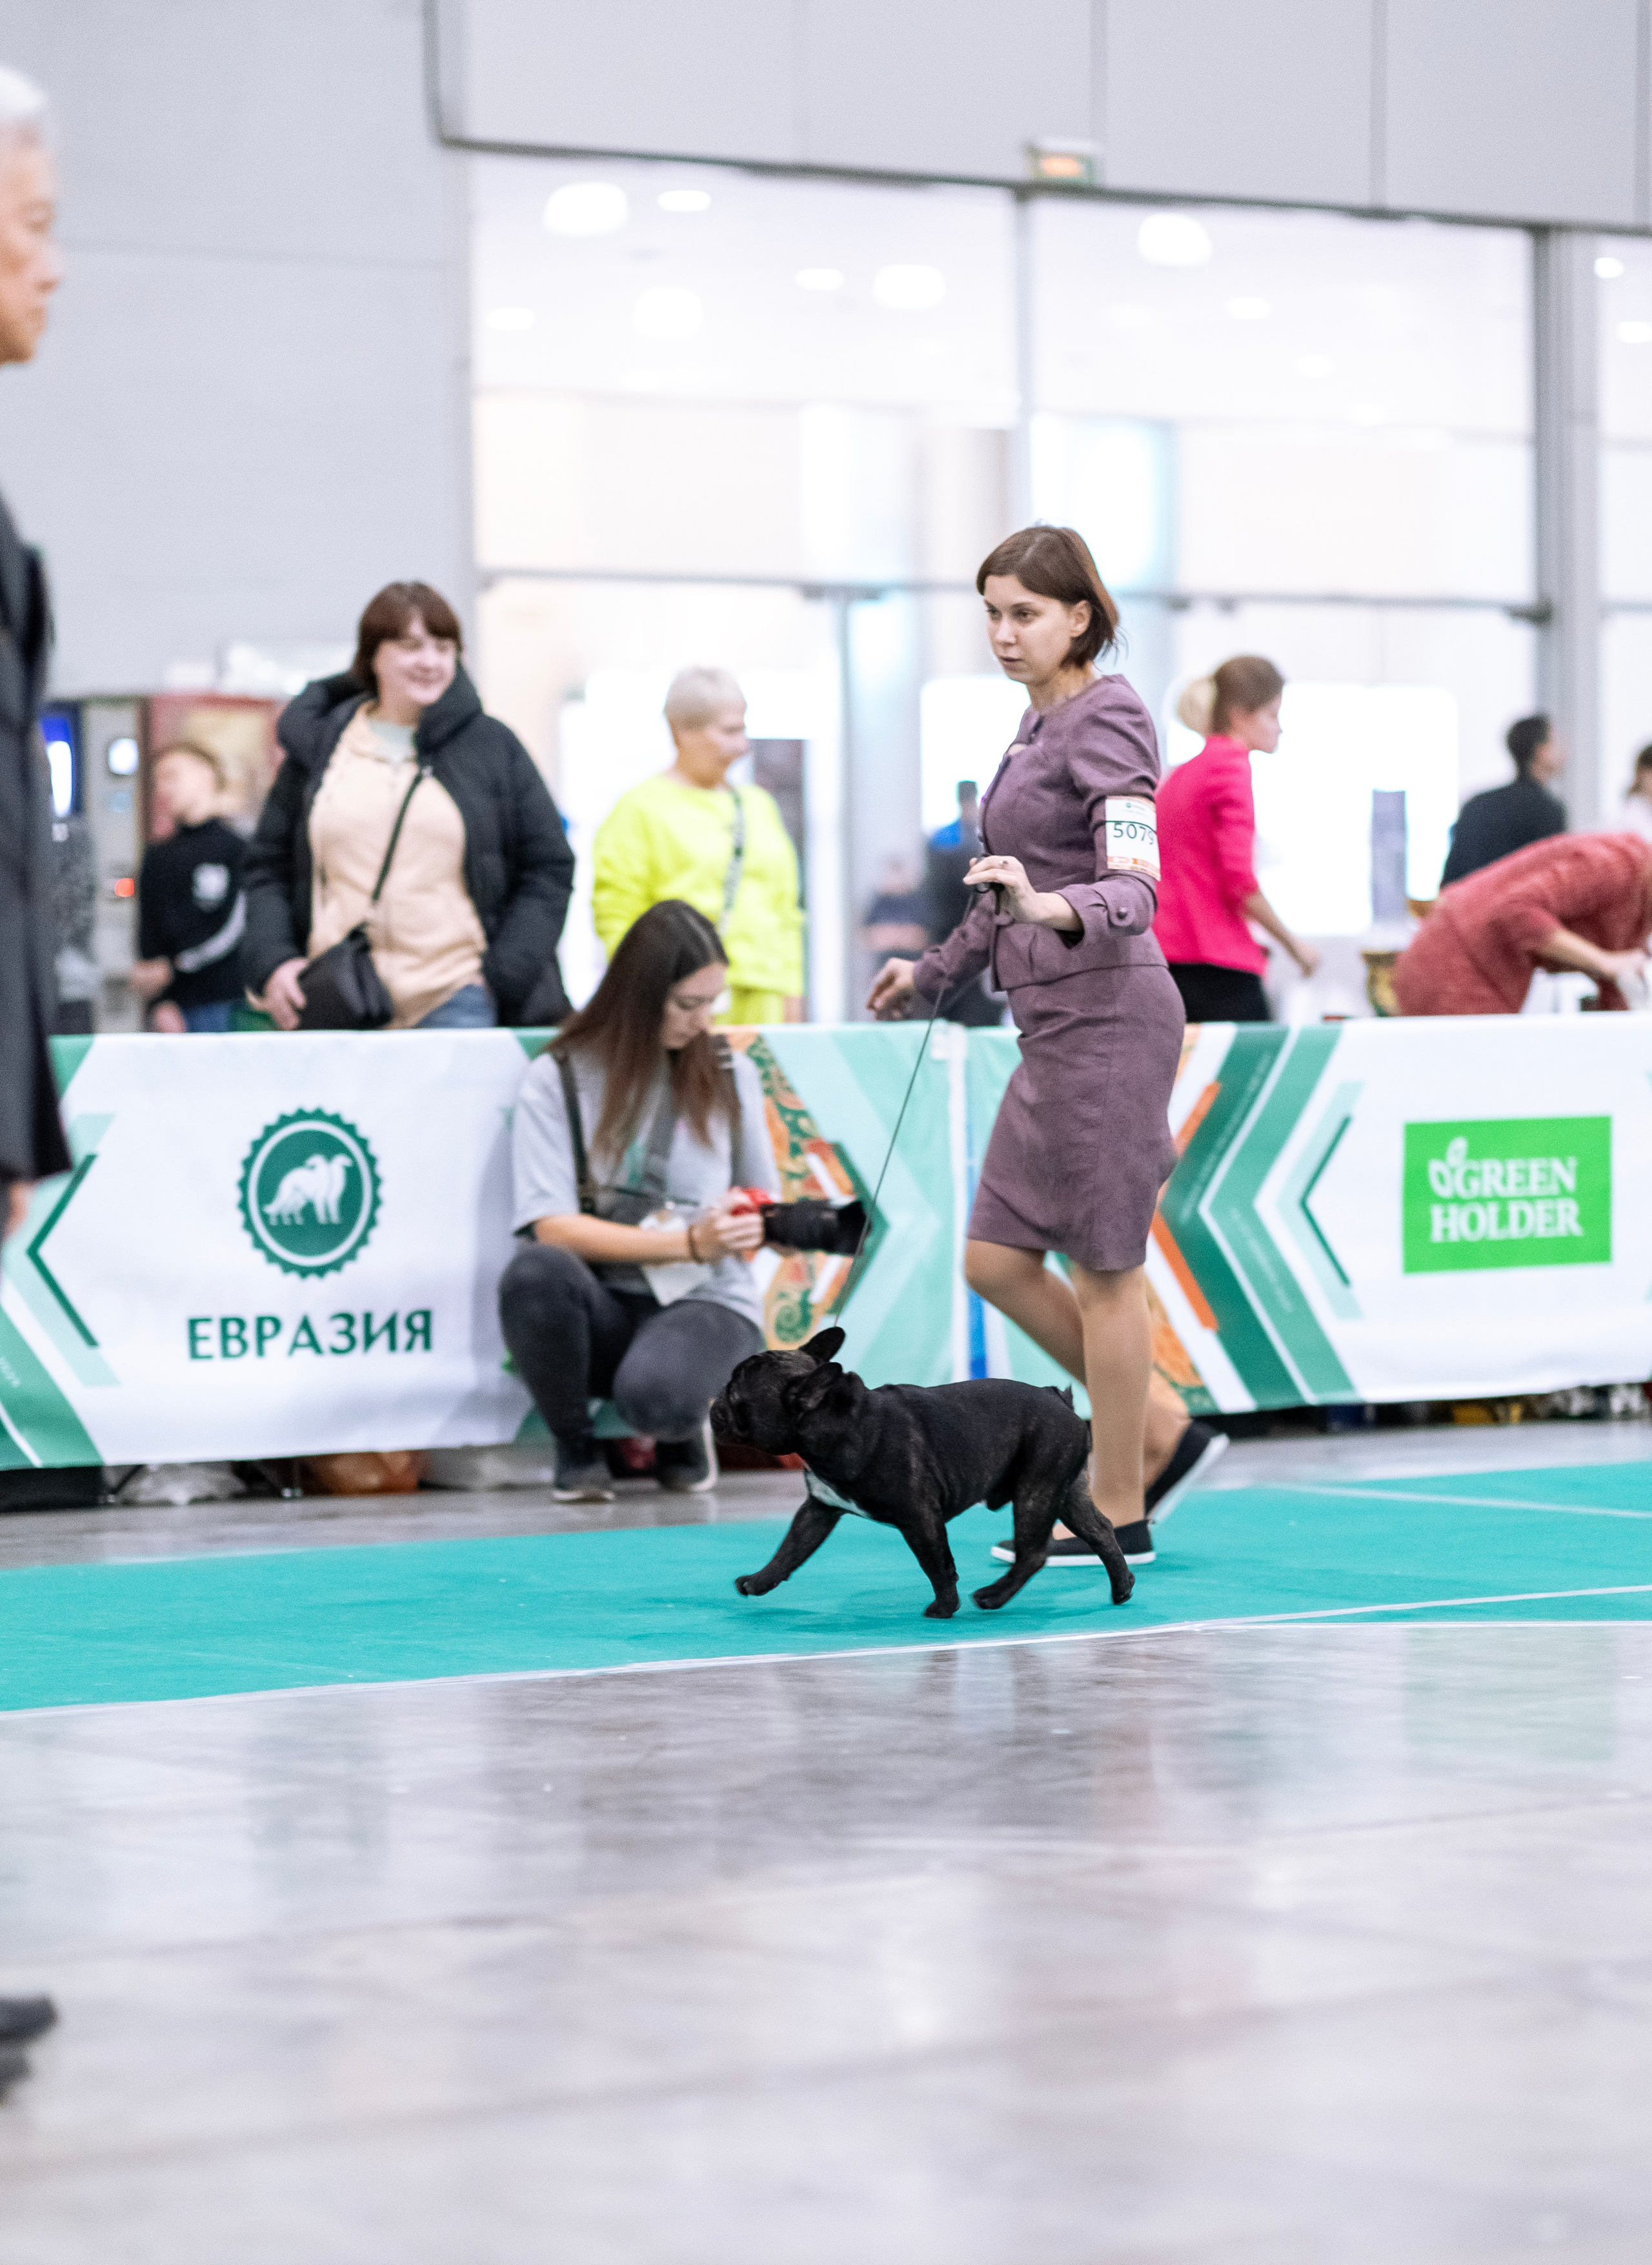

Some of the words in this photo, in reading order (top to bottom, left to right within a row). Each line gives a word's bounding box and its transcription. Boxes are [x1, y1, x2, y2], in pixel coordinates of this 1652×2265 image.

[1113, 823, 1154, 845] 5079
[1453, 1157, 1578, 1199] GREEN
[1430, 1197, 1584, 1242] HOLDER
[188, 1309, 432, 1360] ЕВРАЗИЯ
